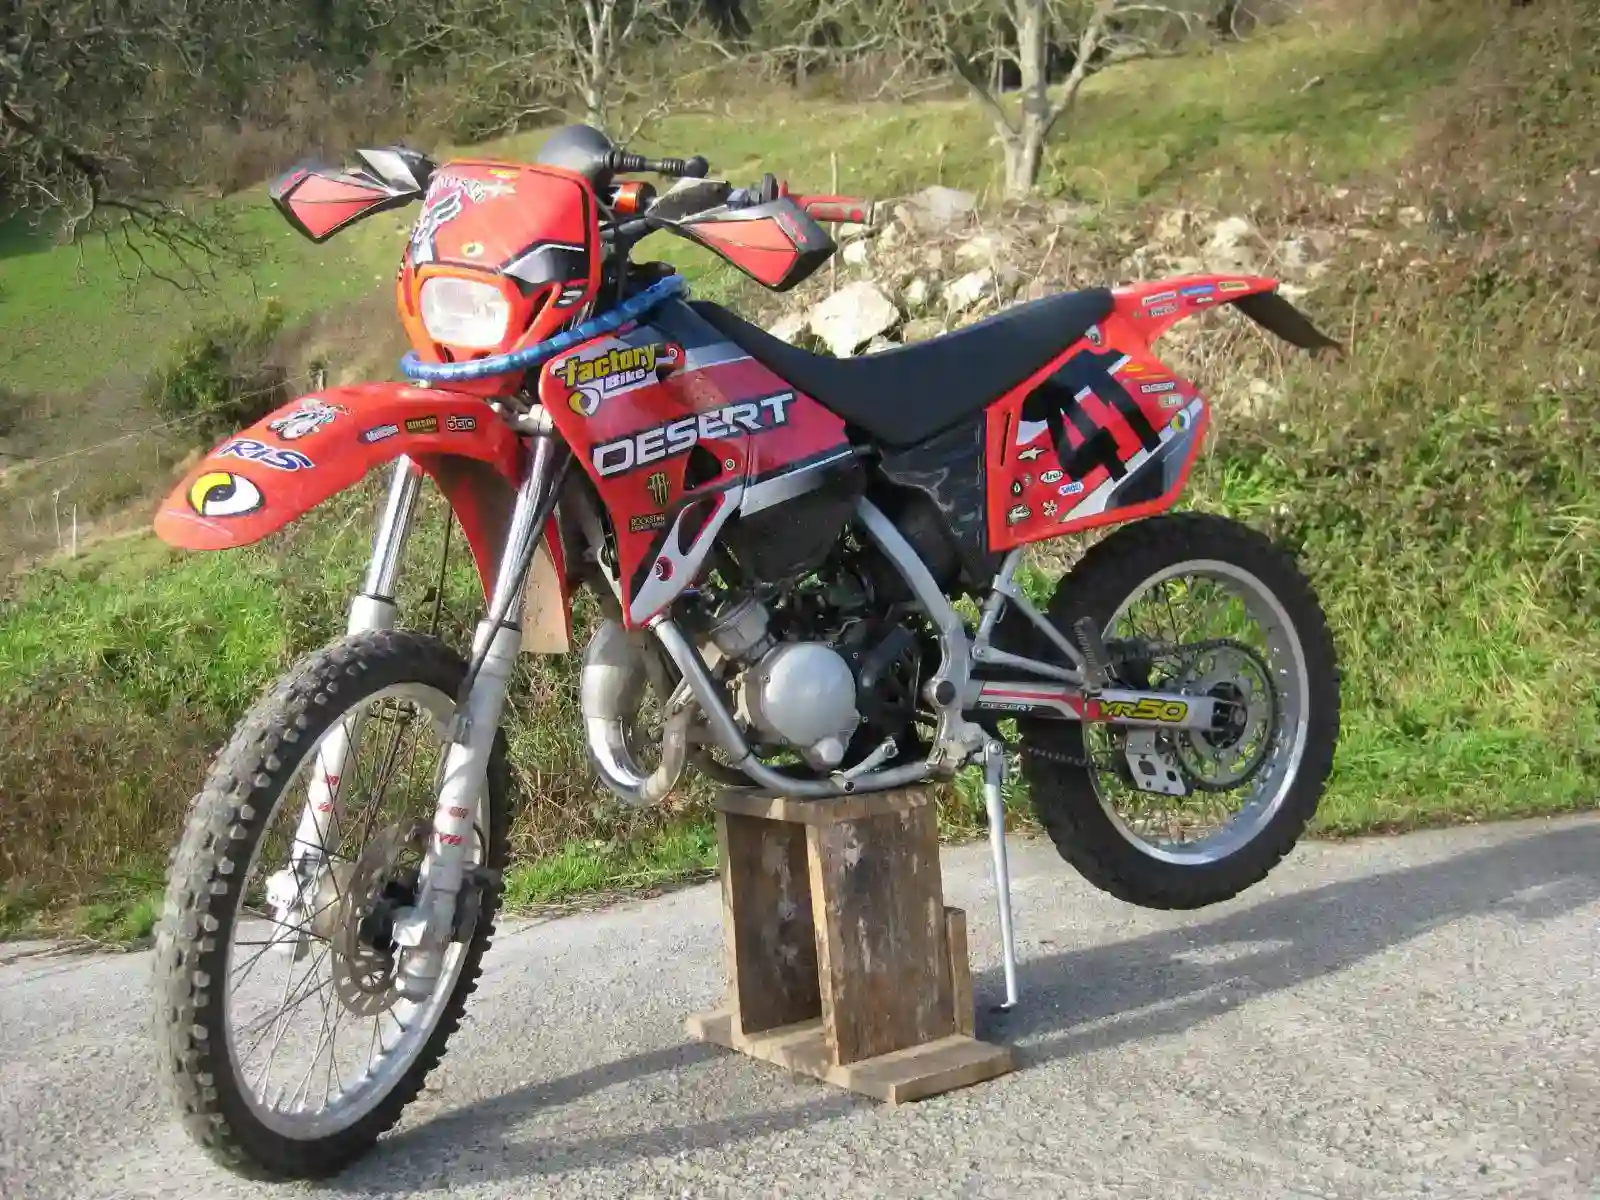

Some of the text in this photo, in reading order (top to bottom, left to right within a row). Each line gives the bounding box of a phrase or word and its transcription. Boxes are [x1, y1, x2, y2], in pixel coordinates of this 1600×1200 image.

[555, 343, 657, 388] factory
[605, 368, 646, 389] Bike
[592, 392, 794, 477] DESERT
[980, 702, 1034, 711] DESERT
